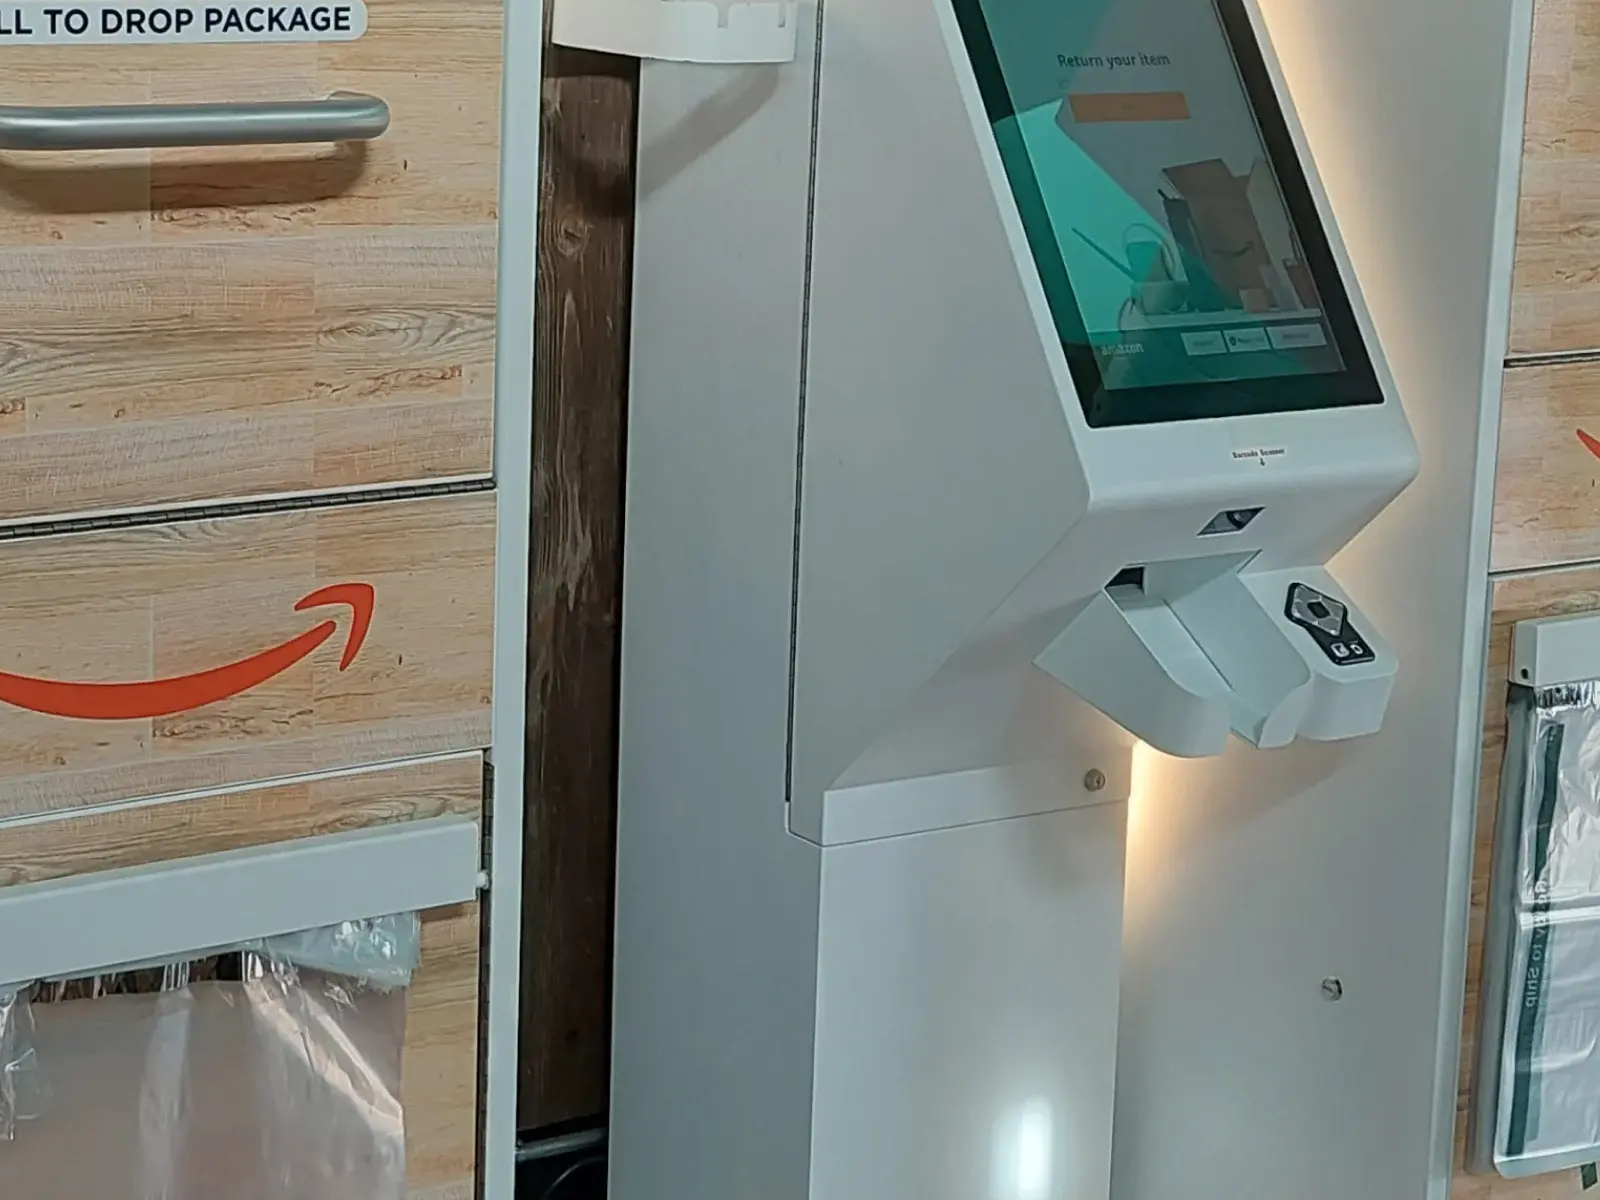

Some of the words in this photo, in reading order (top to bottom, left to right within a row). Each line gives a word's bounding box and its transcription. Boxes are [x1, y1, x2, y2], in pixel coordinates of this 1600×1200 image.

[43, 8, 88, 35] TO
[101, 7, 193, 35] DROP
[204, 6, 351, 33] PACKAGE
[1057, 54, 1104, 68] Return
[1105, 55, 1136, 70] your
[1138, 52, 1171, 66] item
